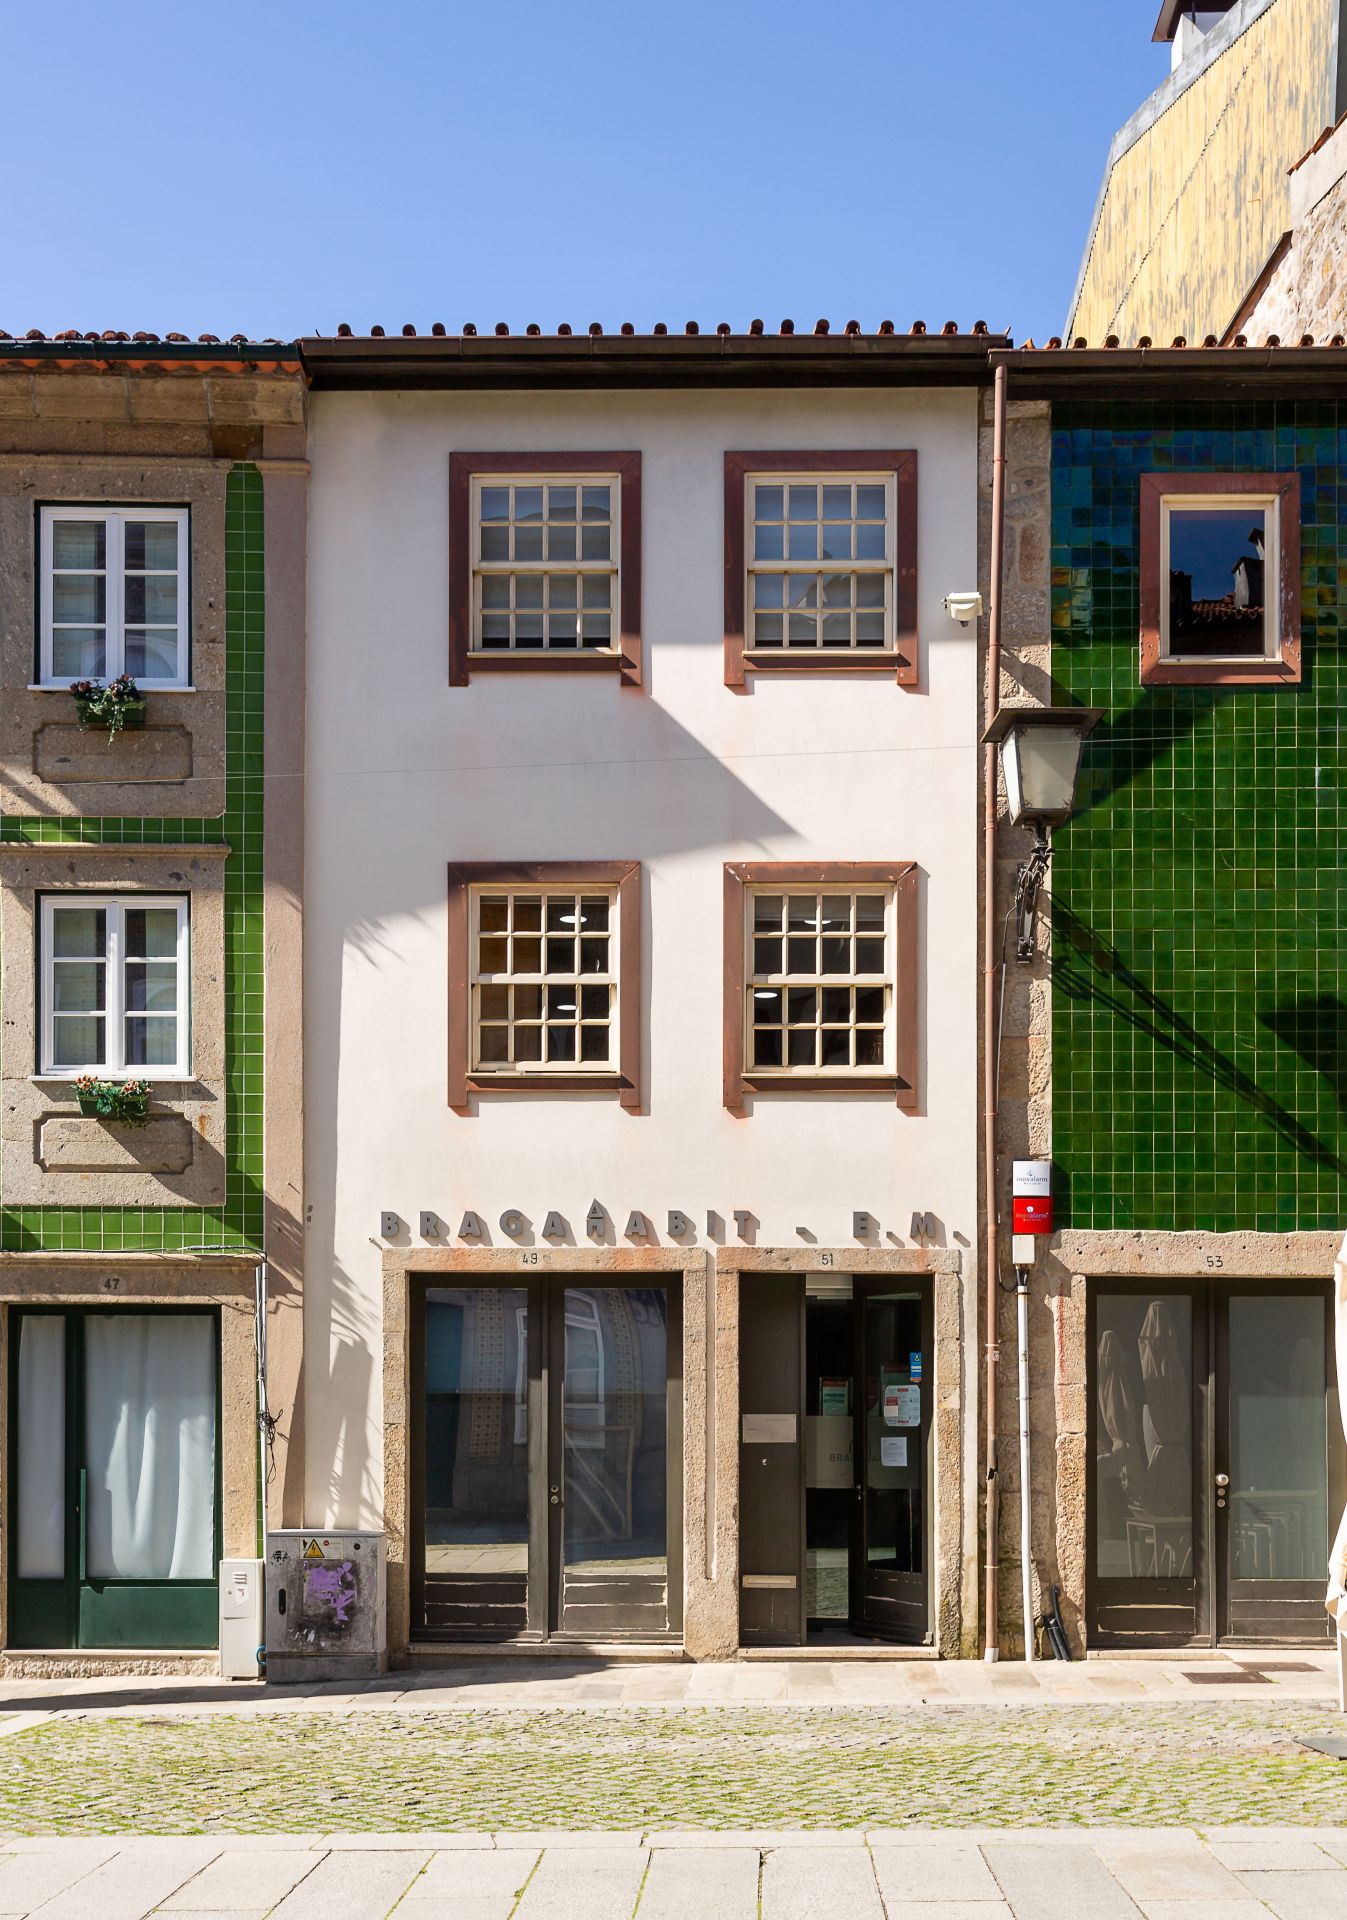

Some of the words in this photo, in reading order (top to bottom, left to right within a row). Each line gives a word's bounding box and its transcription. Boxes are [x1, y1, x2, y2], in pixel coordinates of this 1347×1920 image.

[522, 1252, 538, 1264] 49
[821, 1253, 834, 1266] 51
[1206, 1255, 1224, 1268] 53
[104, 1278, 120, 1290] 47
